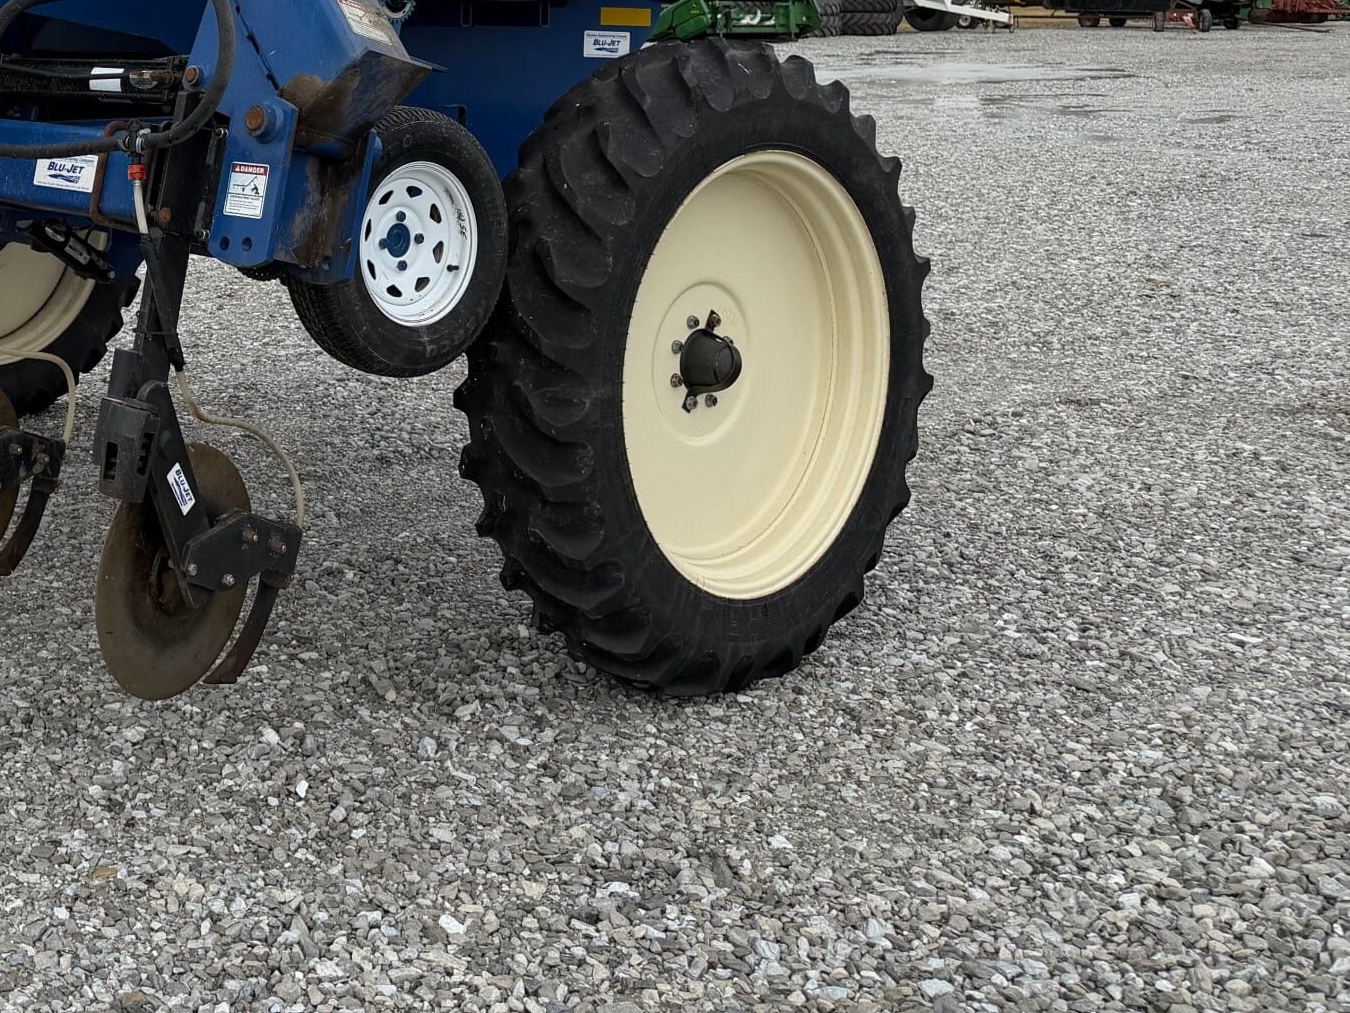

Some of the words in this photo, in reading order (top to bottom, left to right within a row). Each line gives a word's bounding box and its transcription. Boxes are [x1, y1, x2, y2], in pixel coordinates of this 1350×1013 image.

[593, 38, 621, 47] BLU-JET
[47, 161, 85, 174] BLU-JET
[240, 166, 265, 174] DANGER
[174, 469, 193, 501] BLU-JET
